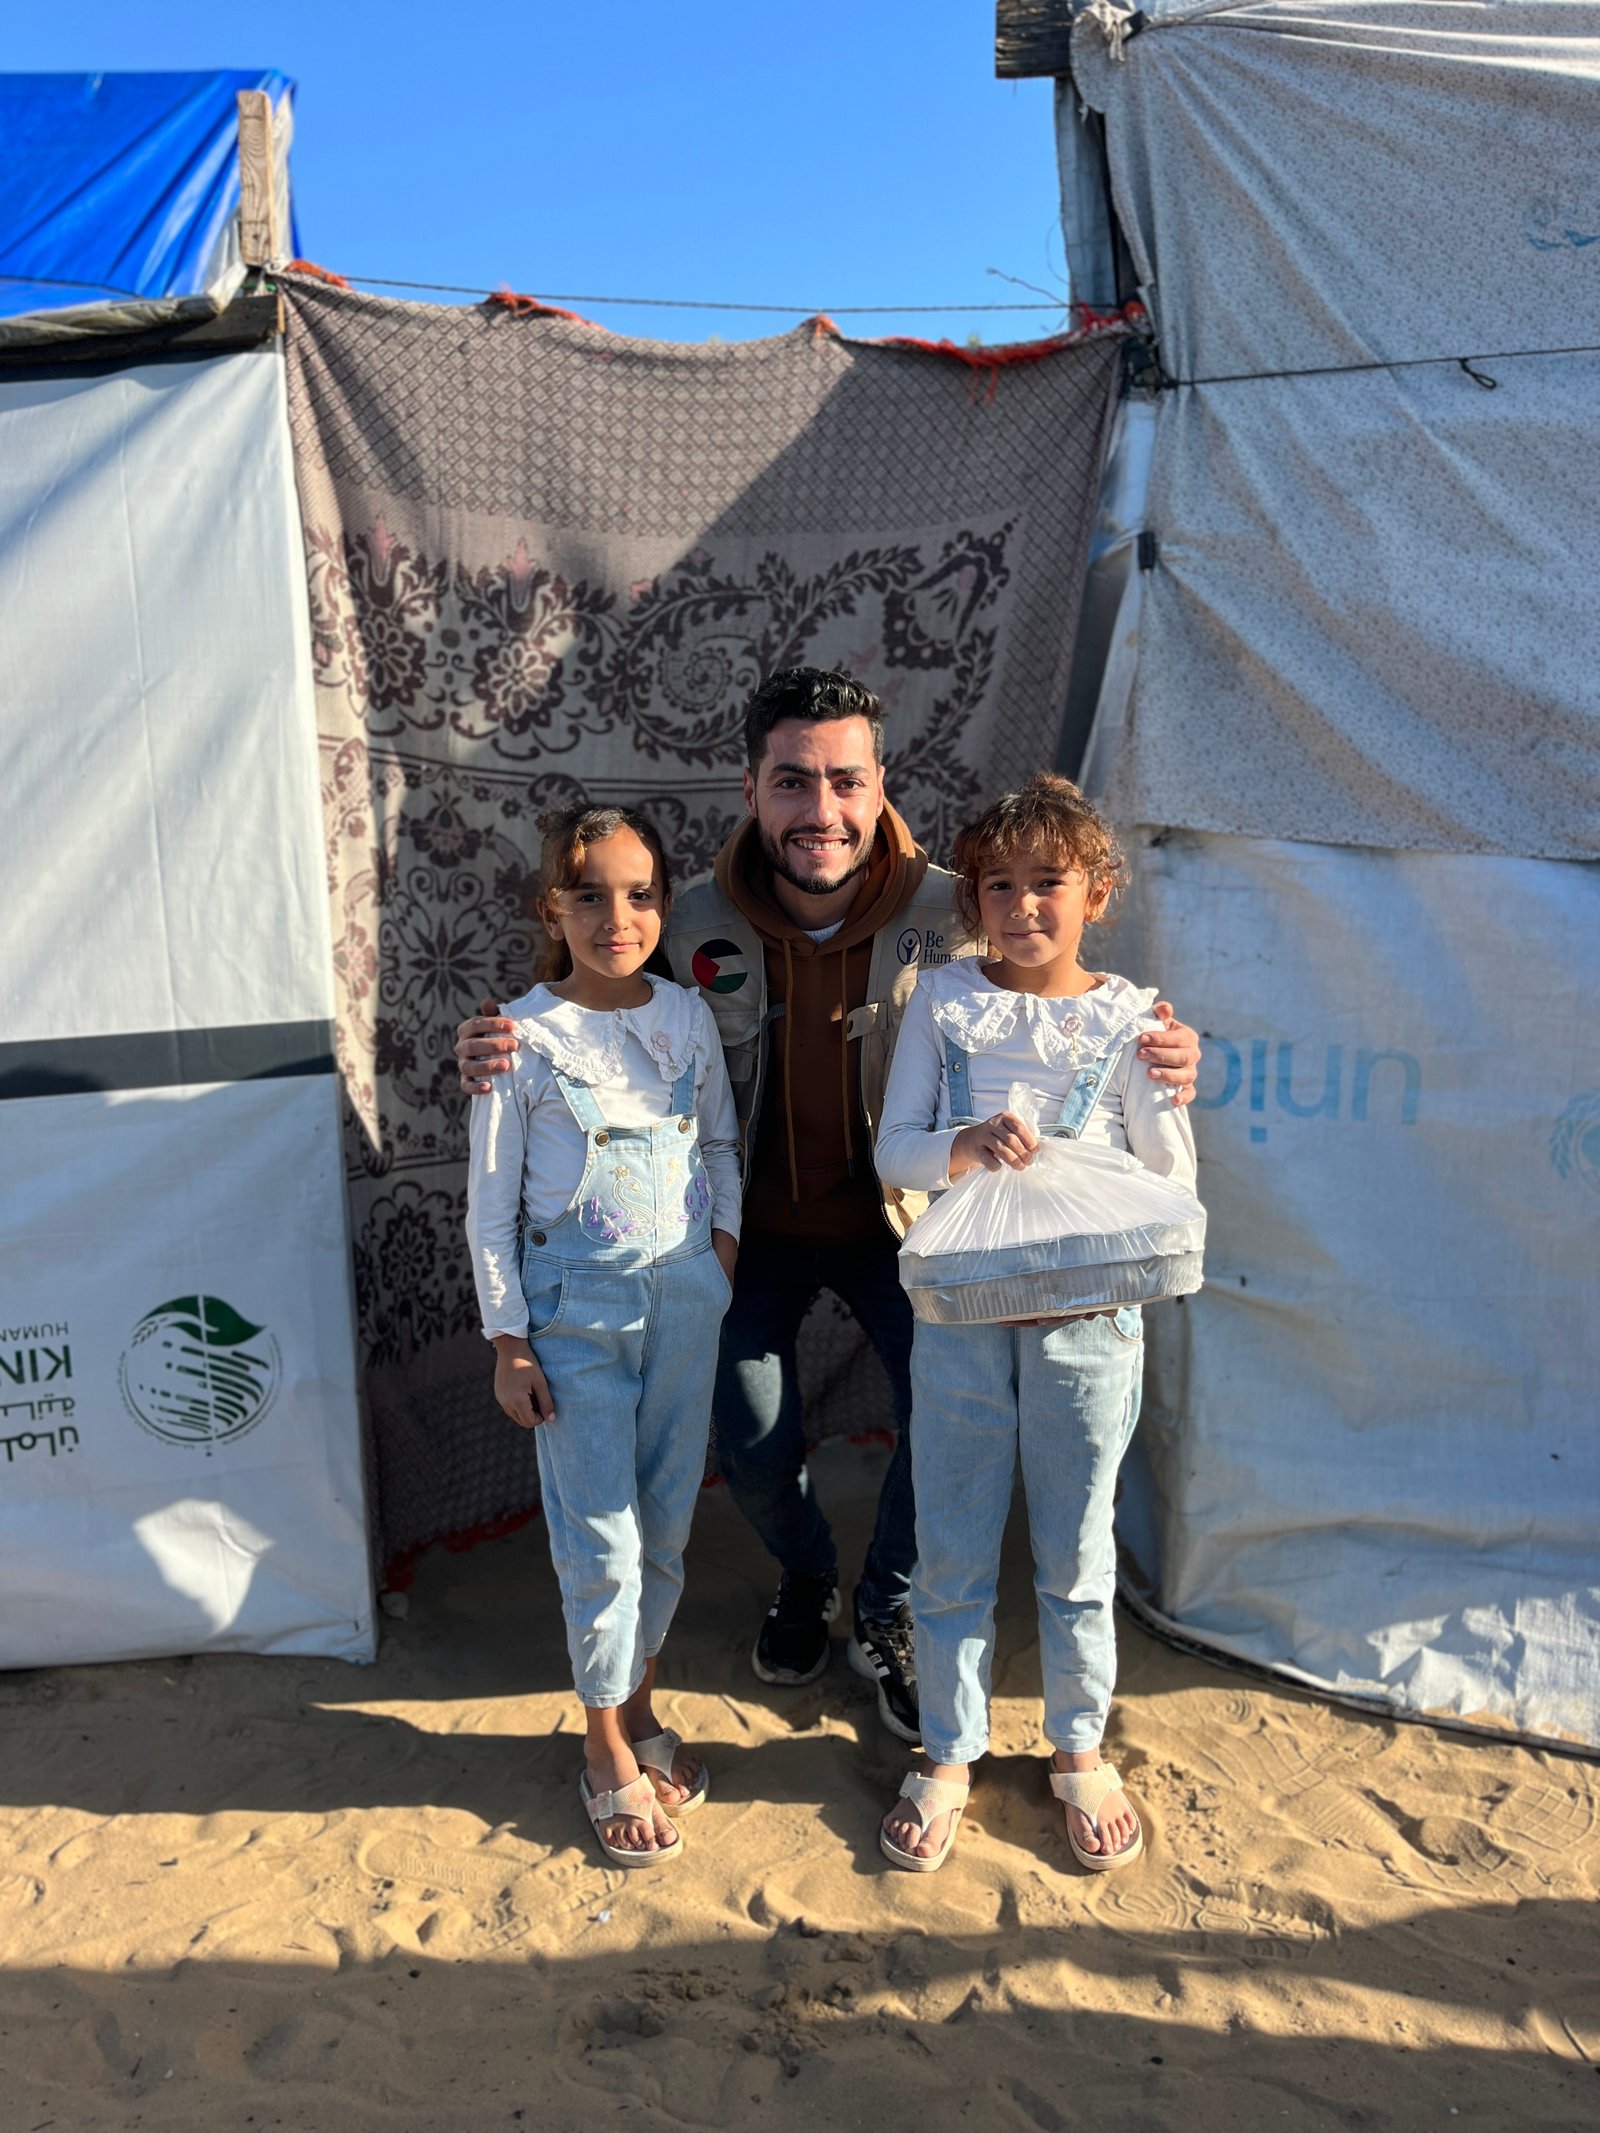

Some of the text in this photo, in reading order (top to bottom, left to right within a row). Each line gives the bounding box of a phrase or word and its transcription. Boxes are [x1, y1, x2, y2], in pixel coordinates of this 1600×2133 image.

[924, 930, 944, 948] Be
[1196, 1036, 1422, 1143] unic
[0, 1426, 79, 1463] لمان
